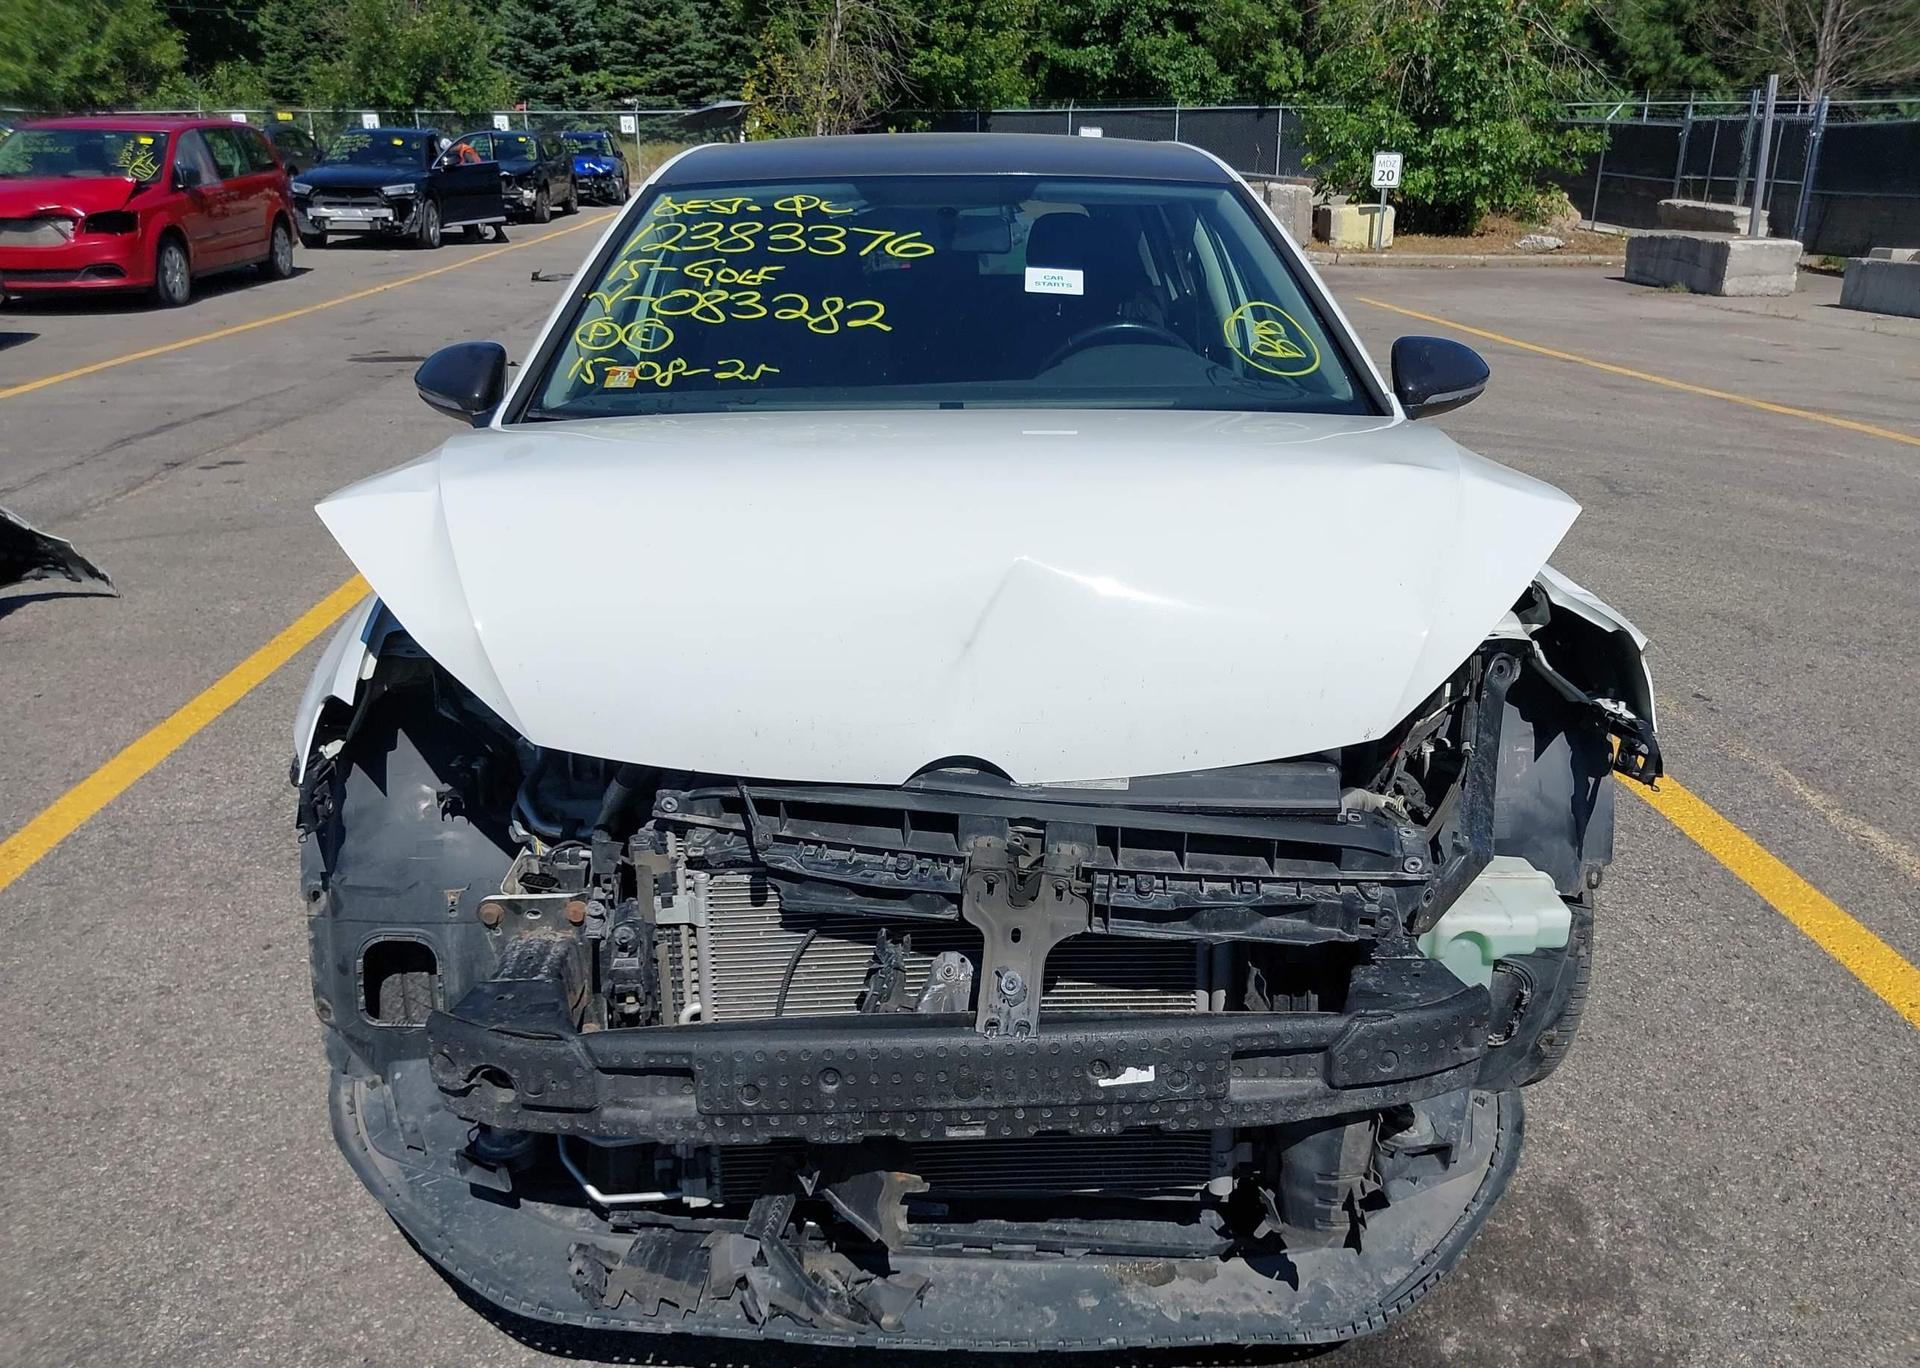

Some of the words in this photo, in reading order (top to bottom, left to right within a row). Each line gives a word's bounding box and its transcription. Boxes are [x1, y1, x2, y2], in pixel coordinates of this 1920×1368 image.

[1379, 160, 1397, 168] MDZ
[1377, 170, 1395, 181] 20
[621, 221, 935, 258] 12383376
[1034, 280, 1073, 288] STARTS
